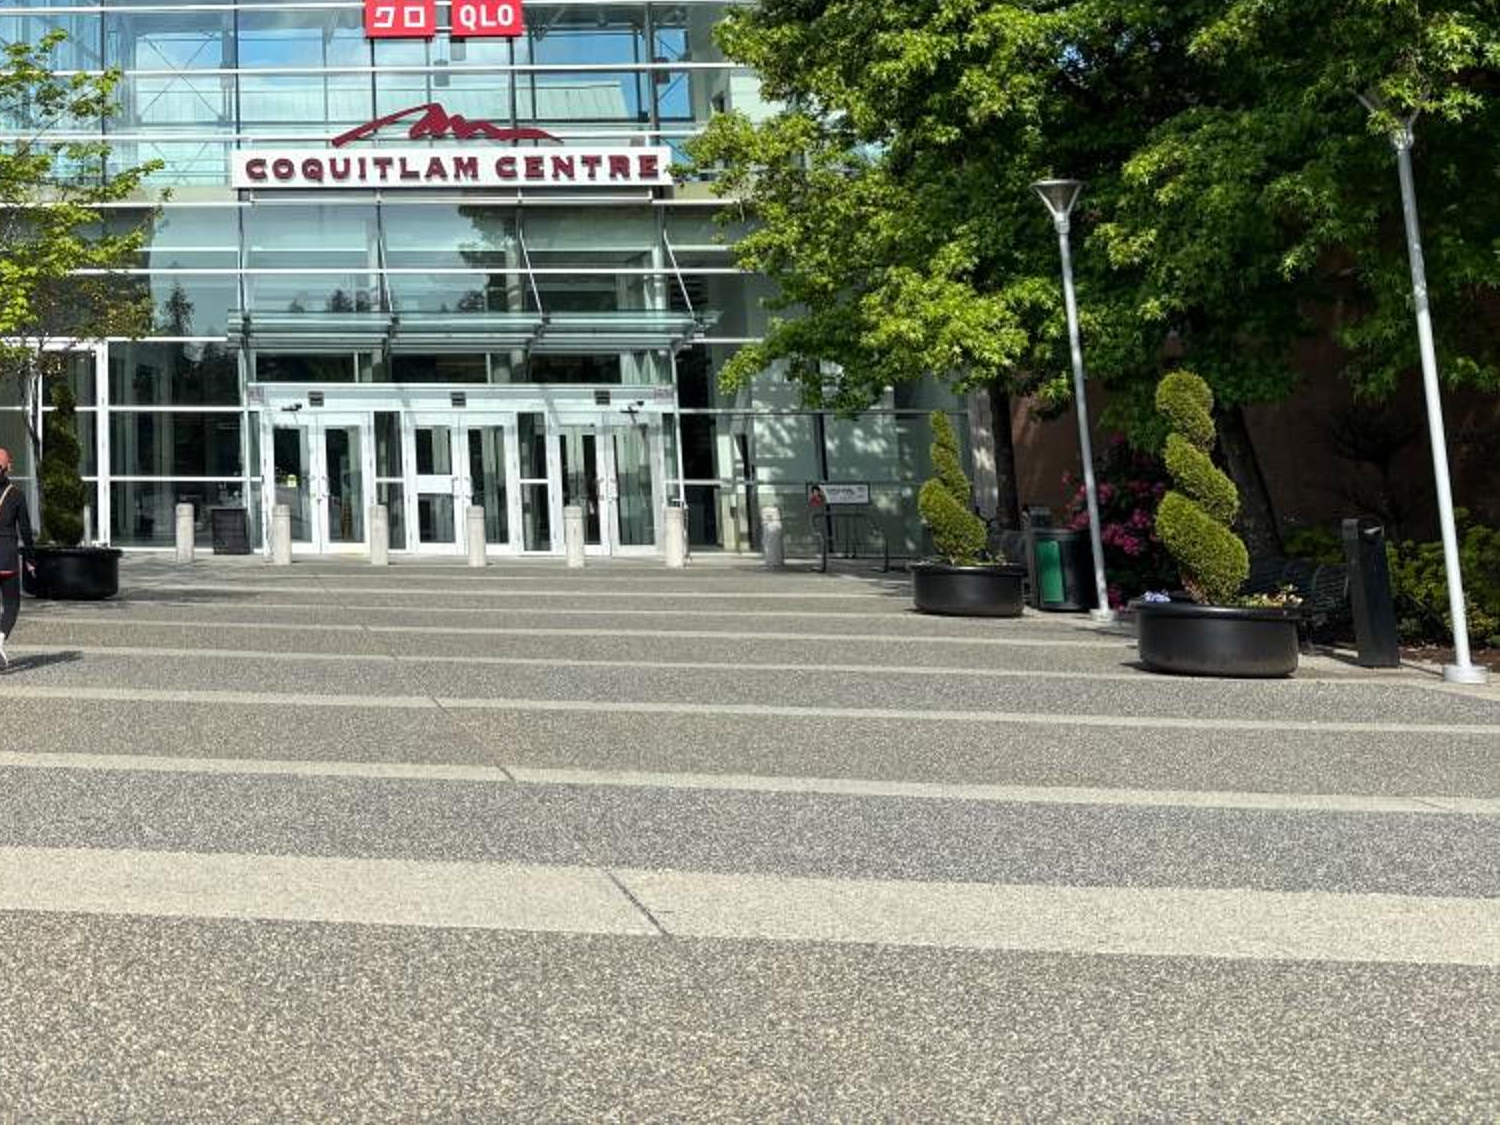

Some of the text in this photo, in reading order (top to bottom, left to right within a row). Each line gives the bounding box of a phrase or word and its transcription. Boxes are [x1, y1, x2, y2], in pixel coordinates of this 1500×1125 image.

[459, 4, 514, 31] QLO
[245, 154, 659, 183] COQUITLAM CENTRE
